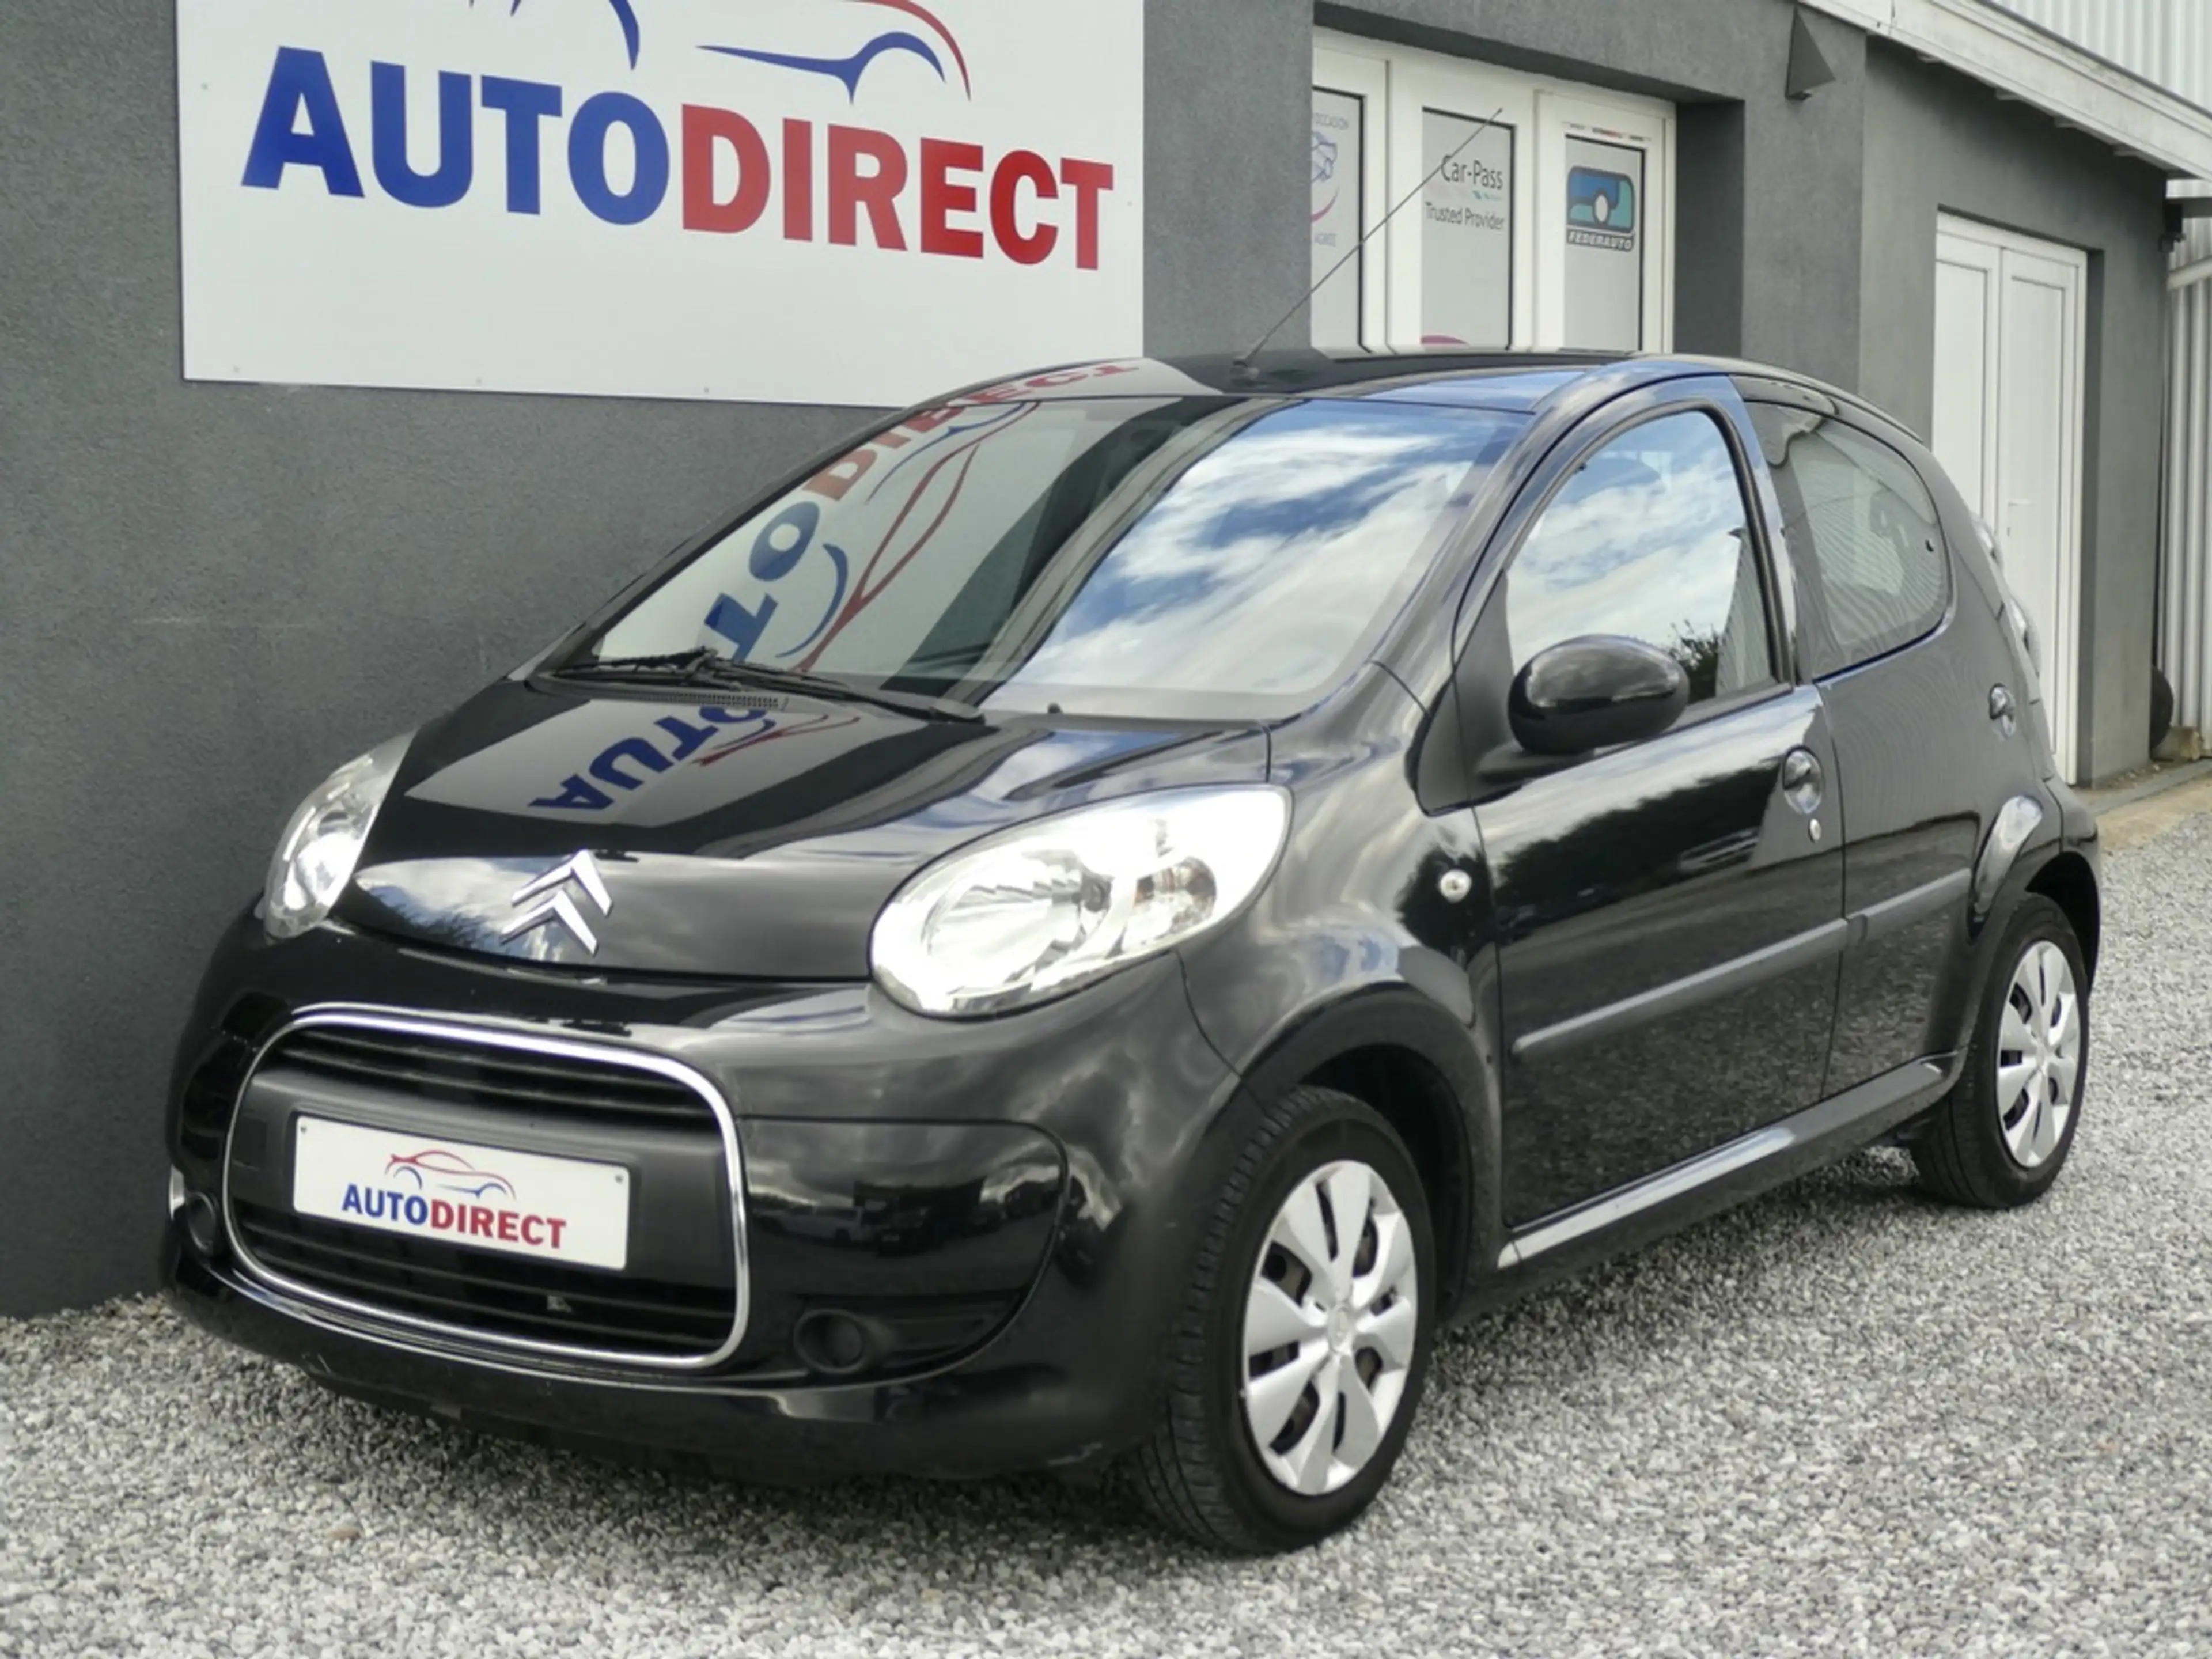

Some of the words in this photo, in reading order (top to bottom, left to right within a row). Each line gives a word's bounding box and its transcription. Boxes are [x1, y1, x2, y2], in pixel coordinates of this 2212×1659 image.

[241, 46, 1114, 271] AUTODIRECT
[1440, 154, 1503, 190] Car-Pass
[1425, 201, 1464, 225] Trusted
[1464, 207, 1505, 230] Provider
[1567, 230, 1633, 251] FEDERAUTO
[342, 1183, 567, 1249] AUTODIRECT
